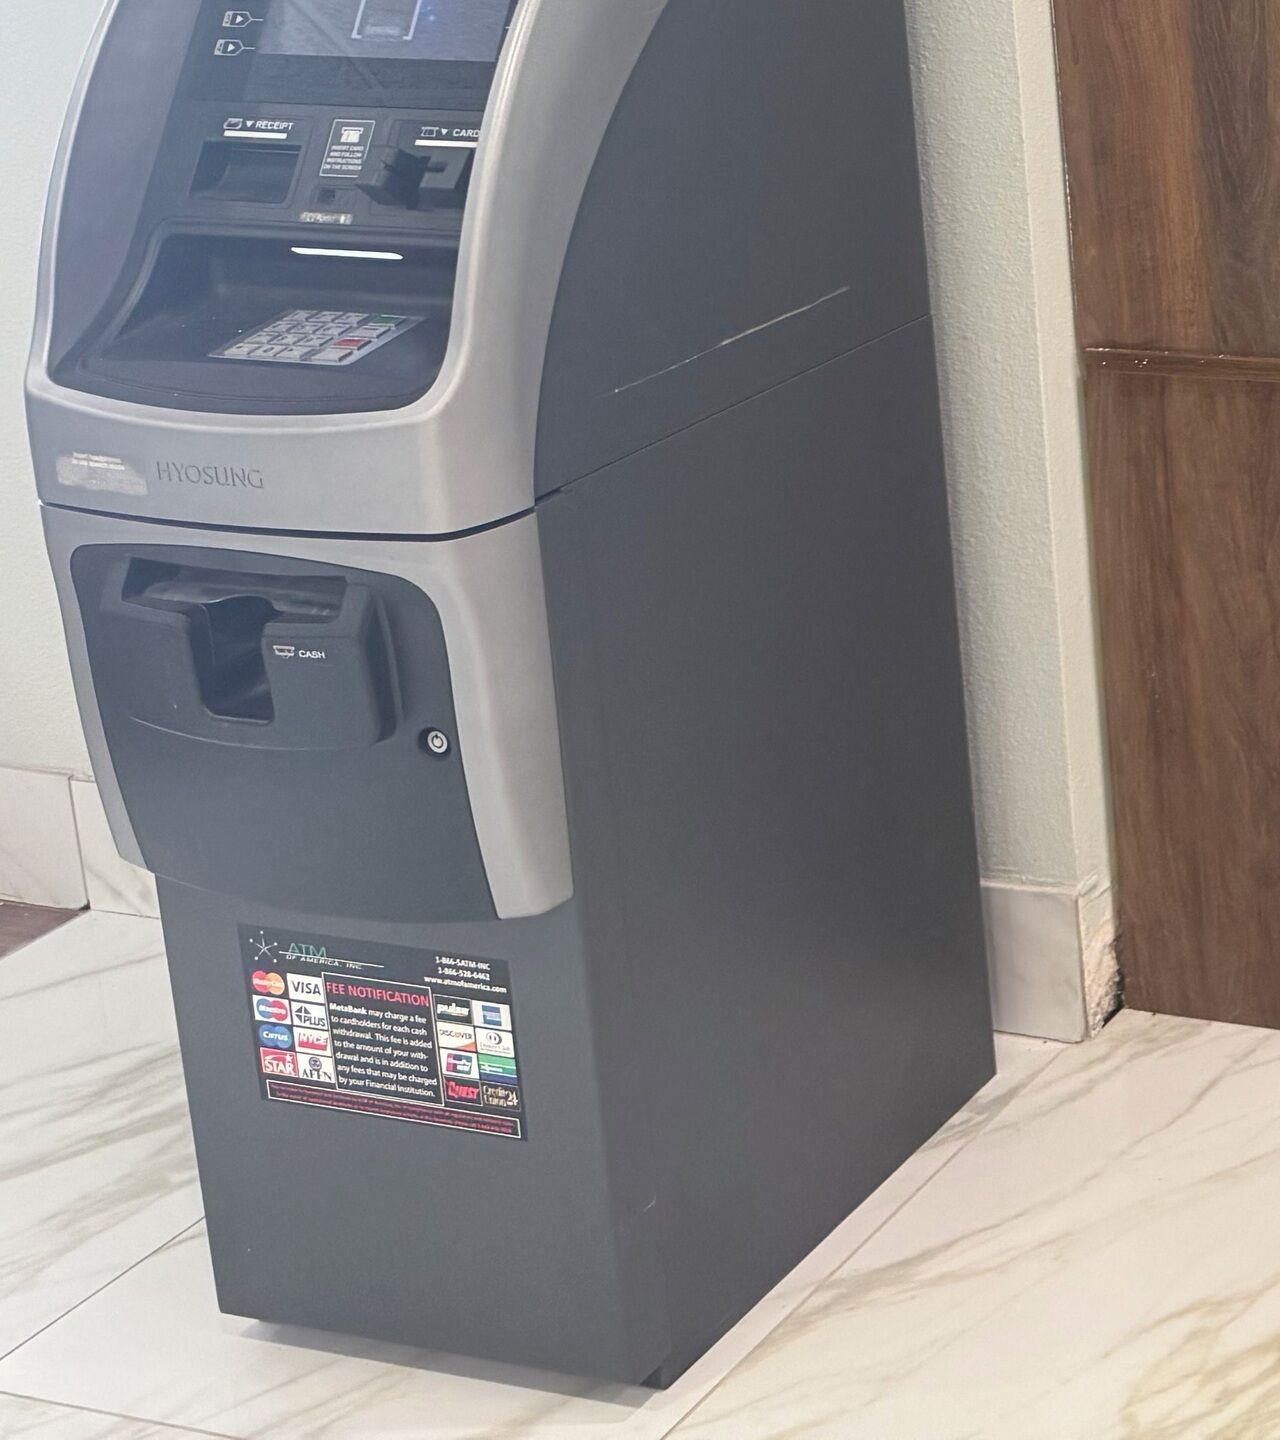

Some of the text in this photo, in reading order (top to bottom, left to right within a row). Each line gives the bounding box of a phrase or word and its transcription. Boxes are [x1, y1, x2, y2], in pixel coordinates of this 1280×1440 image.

[255, 120, 293, 131] RECEIPT
[453, 128, 480, 138] CARD
[156, 461, 265, 489] HYOSUNG
[299, 649, 326, 660] CASH
[288, 943, 327, 958] ATM
[291, 980, 321, 995] VISA
[424, 976, 507, 993] www.atmofamerica.com
[326, 982, 430, 1007] FEE NOTIFICATION
[329, 1002, 367, 1015] MetaBank
[368, 1009, 383, 1019] may
[384, 1011, 409, 1023] charge
[415, 1015, 427, 1024] fee
[304, 1016, 326, 1027] PLUS
[340, 1017, 381, 1029] cardholders
[392, 1024, 410, 1033] each
[411, 1026, 428, 1036] cash
[263, 1031, 288, 1041] Cirrus
[299, 1032, 327, 1045] NYCE
[333, 1028, 373, 1040] withdrawal.
[375, 1033, 390, 1042] This
[410, 1039, 433, 1049] added
[439, 1029, 473, 1040] DISCOVER
[356, 1043, 383, 1053] amount
[392, 1049, 409, 1057] your
[264, 1060, 294, 1075] STAR
[336, 1052, 359, 1061] drawal
[360, 1055, 374, 1063] and
[389, 1059, 419, 1071] addition
[337, 1066, 350, 1074] any
[351, 1065, 366, 1075] fees
[366, 1067, 381, 1077] that
[382, 1071, 397, 1080] may
[408, 1074, 437, 1086] charged
[349, 1078, 365, 1087] your
[365, 1080, 396, 1091] Financial
